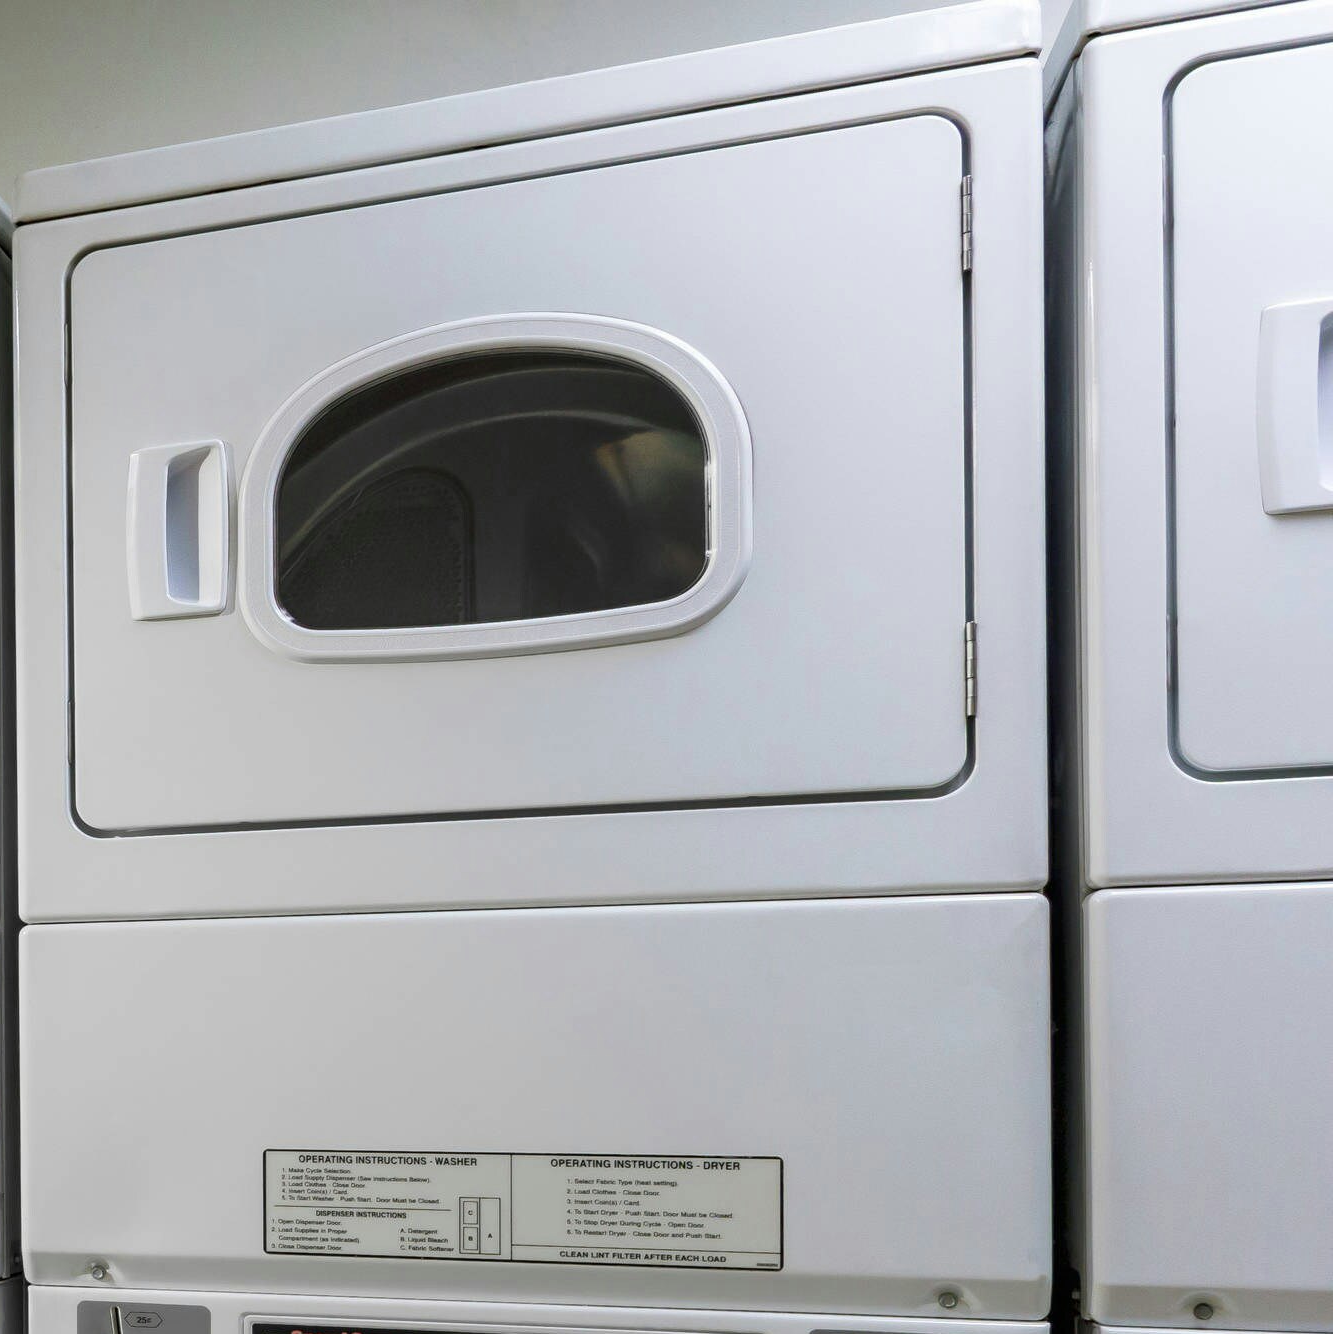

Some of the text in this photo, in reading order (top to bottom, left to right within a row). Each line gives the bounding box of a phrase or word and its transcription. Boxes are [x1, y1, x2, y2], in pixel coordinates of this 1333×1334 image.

[299, 1155, 477, 1166] OPERATING INSTRUCTIONS WASHER
[551, 1159, 740, 1170] OPERATING INSTRUCTIONS DRYER
[356, 1211, 406, 1219] INSTRUCTIONS
